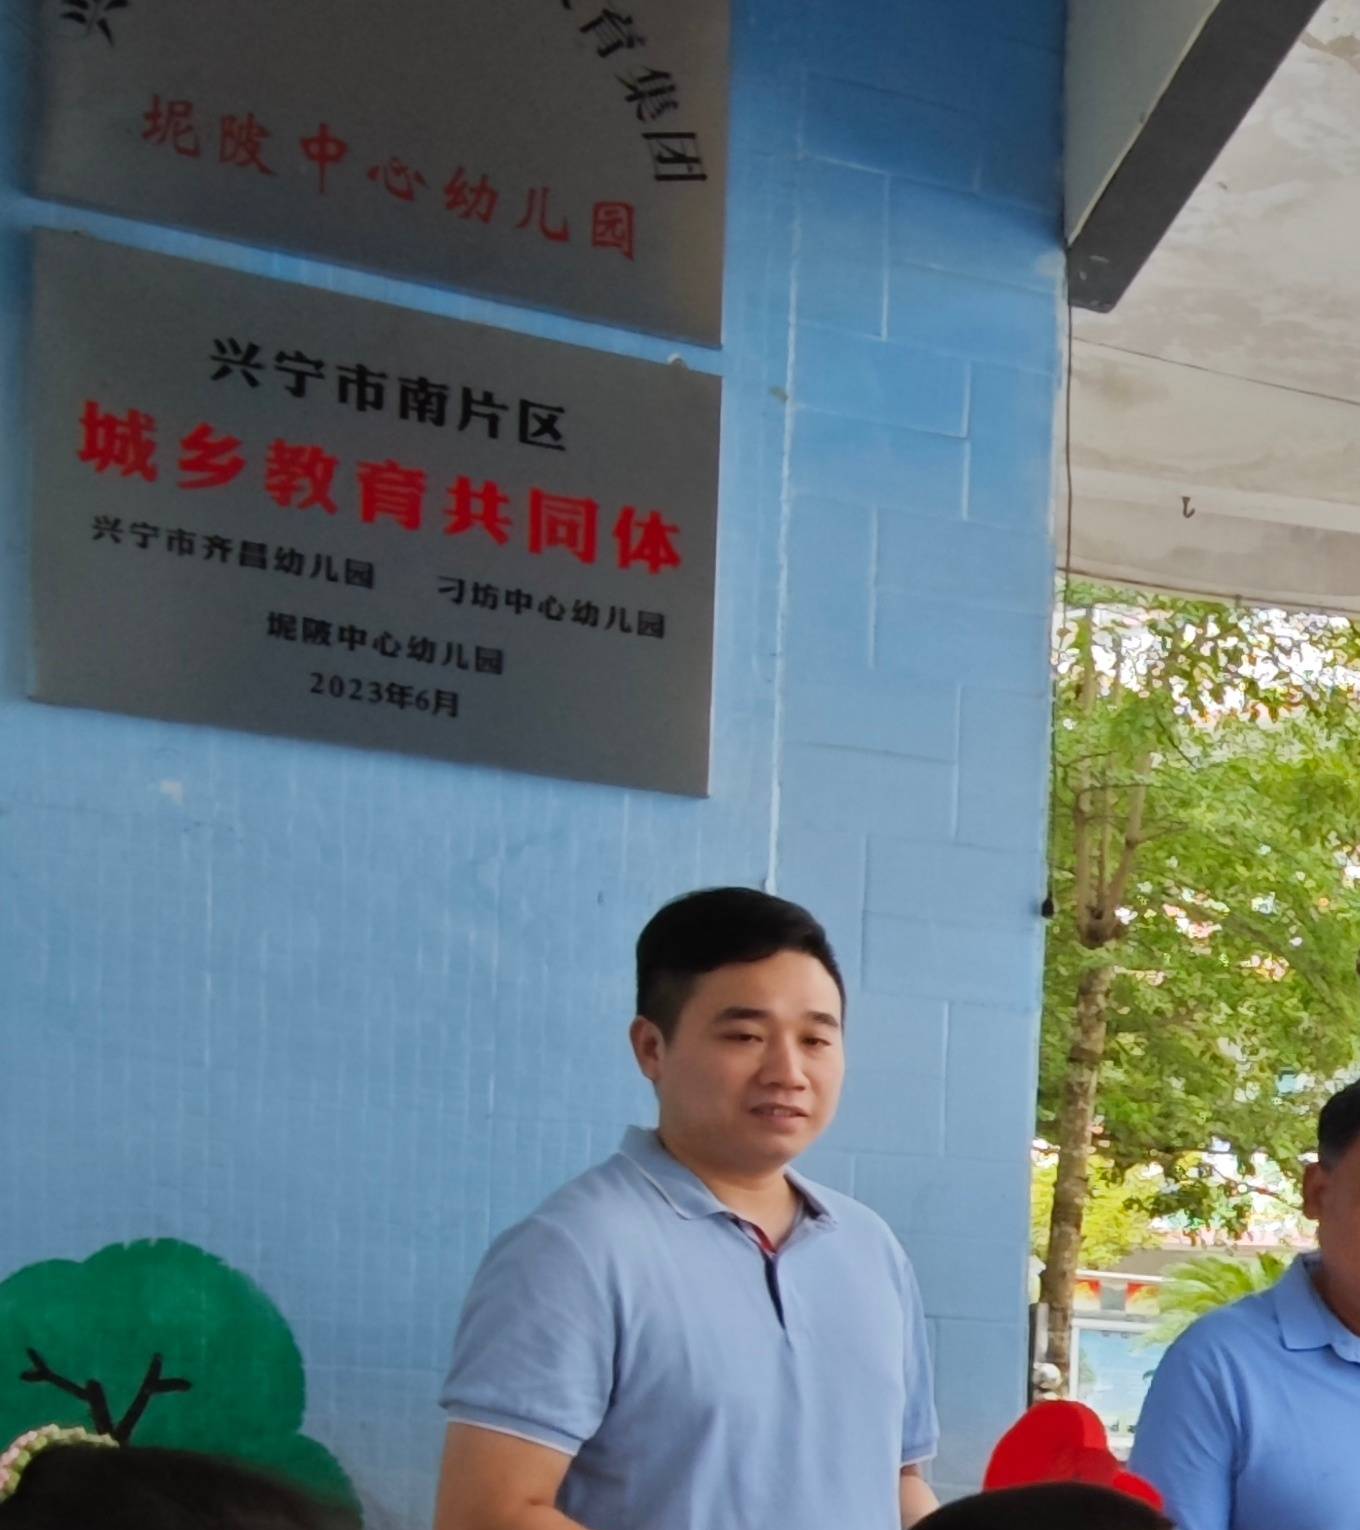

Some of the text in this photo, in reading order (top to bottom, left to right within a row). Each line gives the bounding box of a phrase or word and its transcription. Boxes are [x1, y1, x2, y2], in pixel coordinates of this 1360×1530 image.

[560, 0, 708, 183] 育集团
[210, 337, 568, 451] 兴宁市南片区
[77, 402, 681, 574] 城乡教育共同体
[92, 515, 375, 588] 兴宁市齐昌幼儿园
[309, 672, 460, 718] 2023年6月
